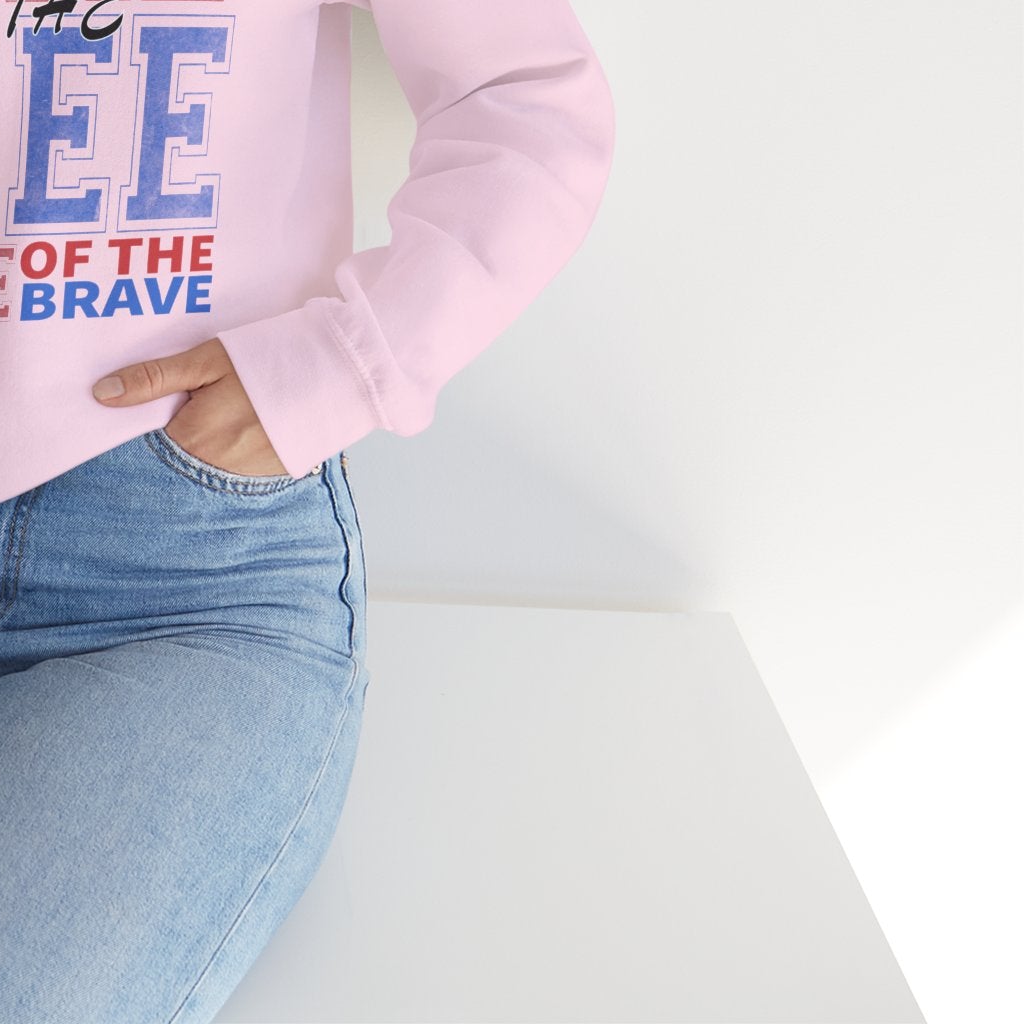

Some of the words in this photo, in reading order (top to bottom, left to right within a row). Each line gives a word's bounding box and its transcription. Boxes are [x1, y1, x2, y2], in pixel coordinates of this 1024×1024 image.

[19, 235, 93, 279] OF
[108, 234, 215, 275] THE
[19, 274, 213, 322] BRAVE
